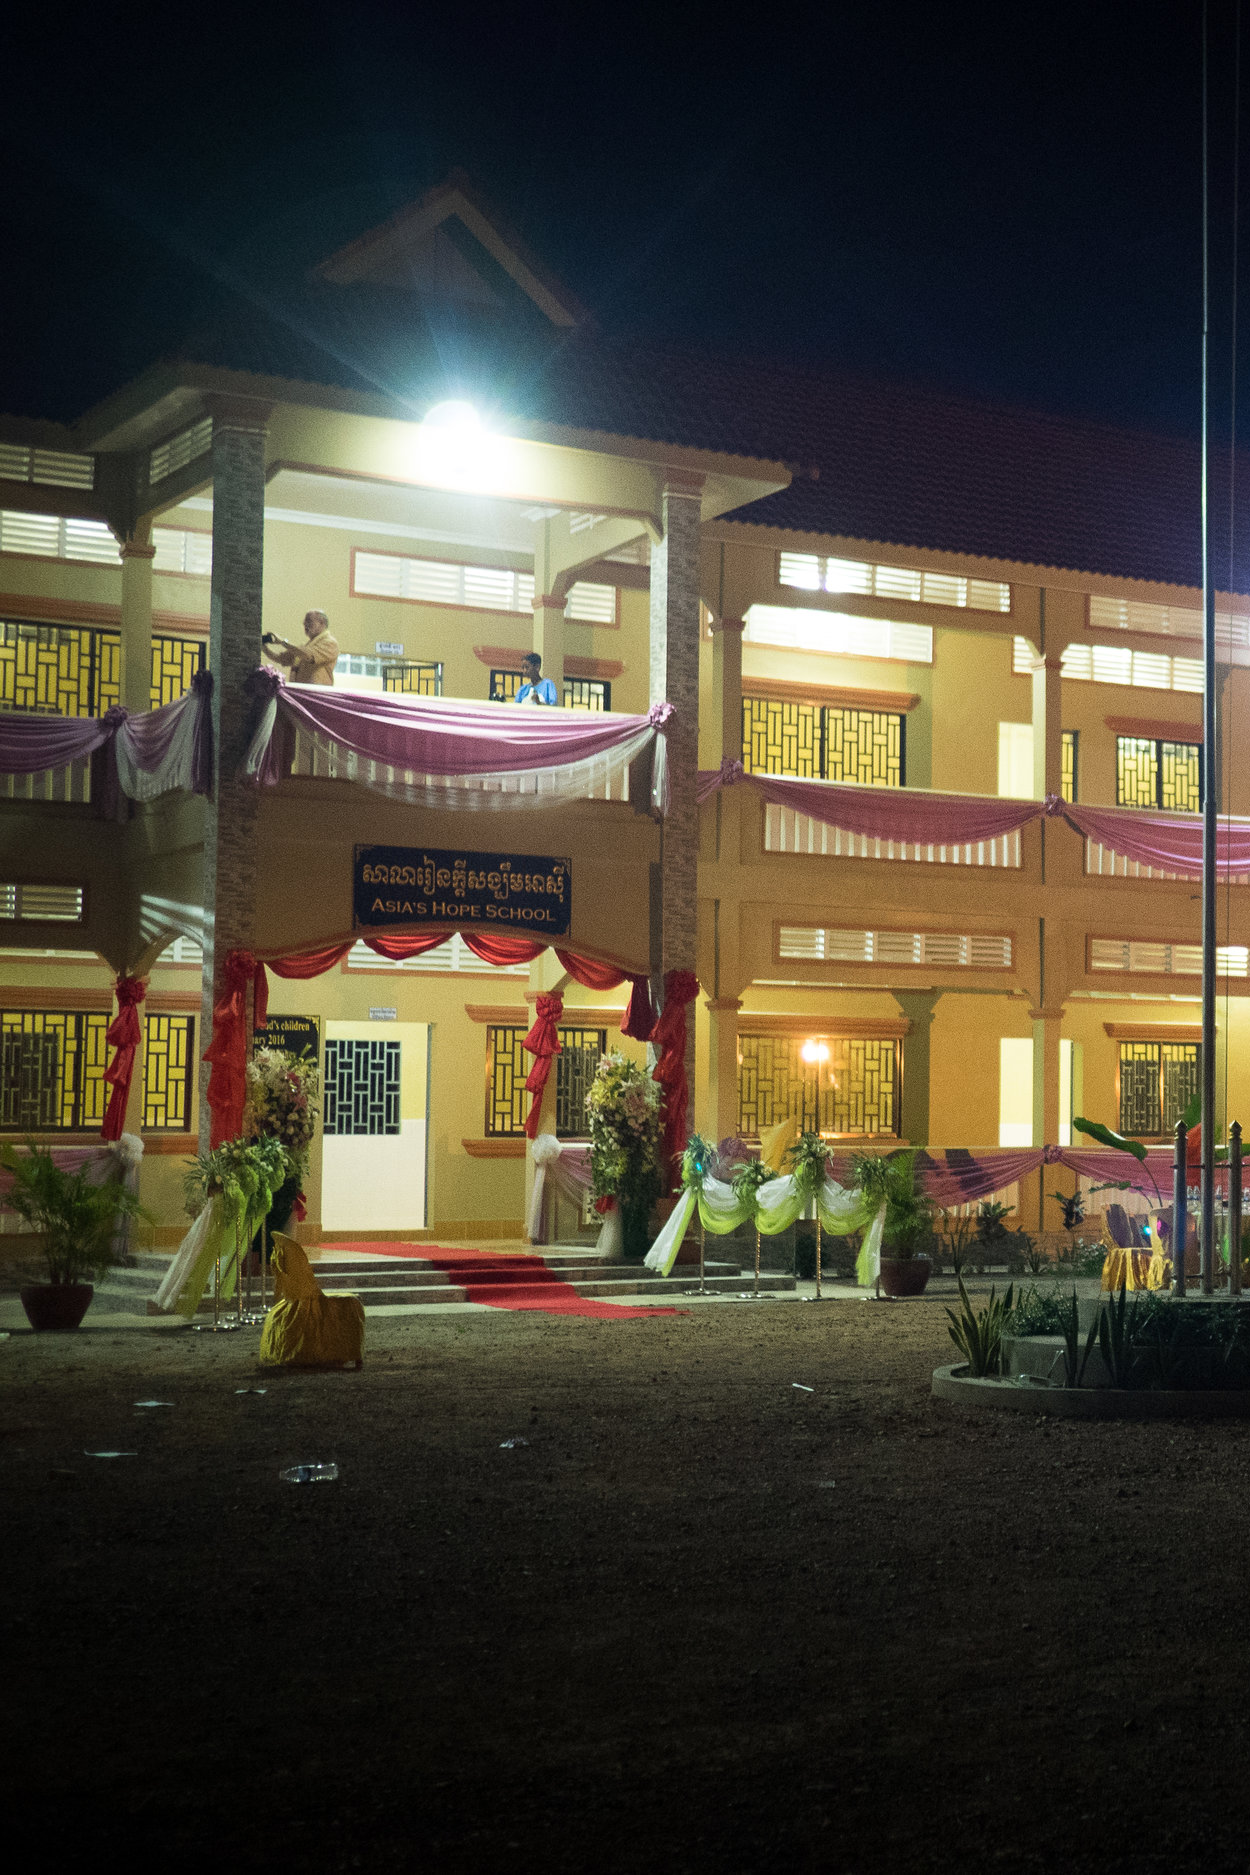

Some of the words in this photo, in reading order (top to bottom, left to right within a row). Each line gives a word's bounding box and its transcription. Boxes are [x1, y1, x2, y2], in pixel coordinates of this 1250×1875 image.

[371, 897, 427, 914] ASIA'S
[432, 900, 481, 917] HOPE
[486, 904, 556, 921] SCHOOL
[280, 1020, 310, 1031] children
[268, 1034, 285, 1046] 2016
